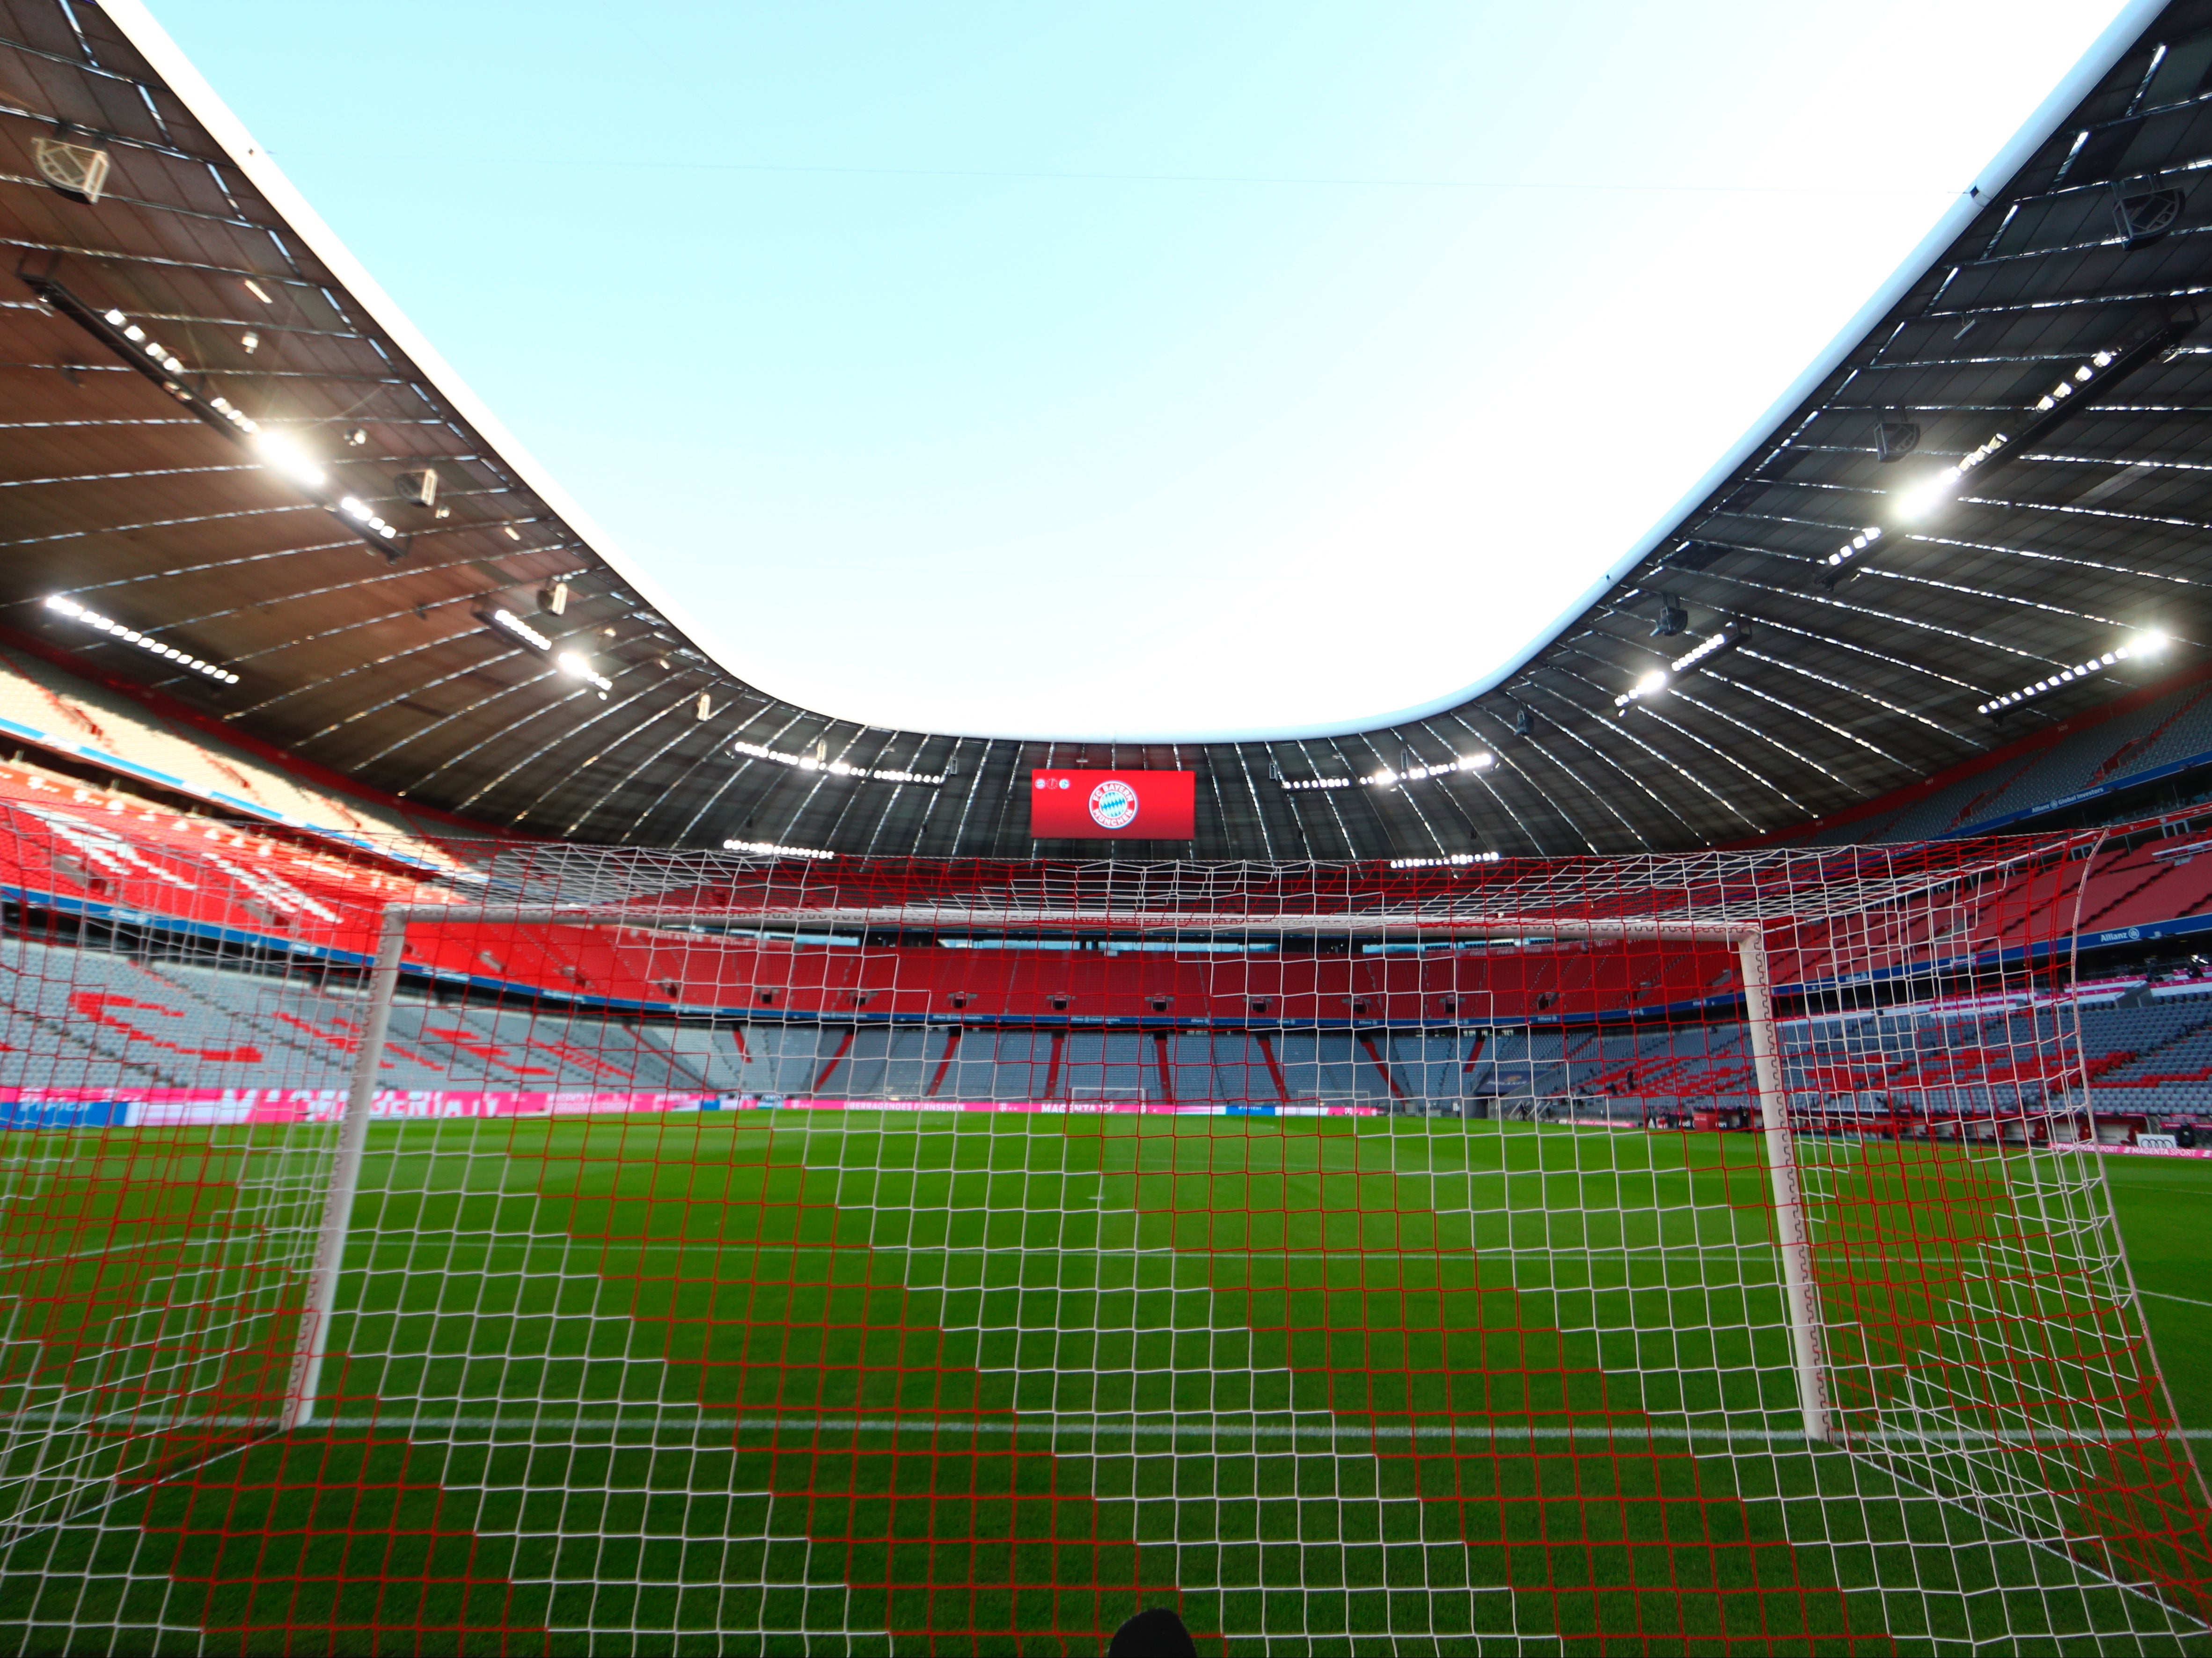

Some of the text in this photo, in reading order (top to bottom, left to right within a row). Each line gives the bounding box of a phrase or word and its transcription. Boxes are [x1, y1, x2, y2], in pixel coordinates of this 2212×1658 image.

[1092, 783, 1134, 802] FC BAYERN
[2032, 787, 2104, 814] Allianz Global Investors
[2100, 932, 2128, 942] Allianz
[2131, 1147, 2197, 1157] MAGENTA SPORT
